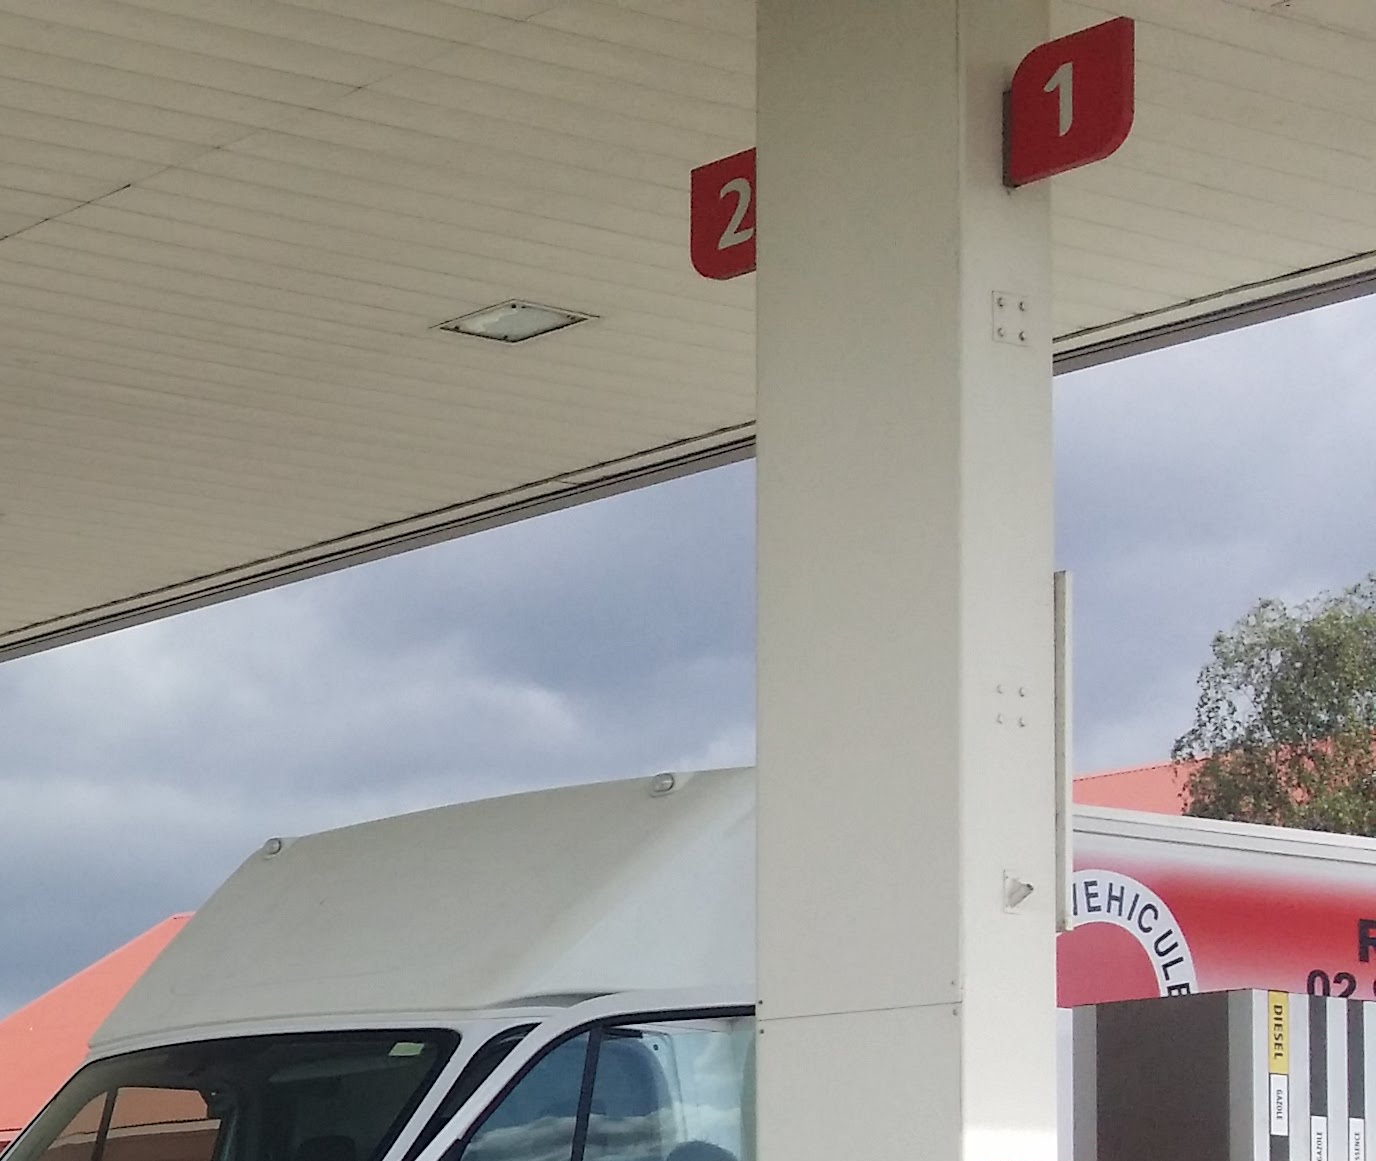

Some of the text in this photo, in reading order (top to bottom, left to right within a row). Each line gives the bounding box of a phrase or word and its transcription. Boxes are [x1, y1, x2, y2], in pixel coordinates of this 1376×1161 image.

[1043, 61, 1075, 138] 1
[717, 177, 756, 251] 2
[1307, 969, 1357, 998] 02
[1273, 1003, 1284, 1060] DIESEL
